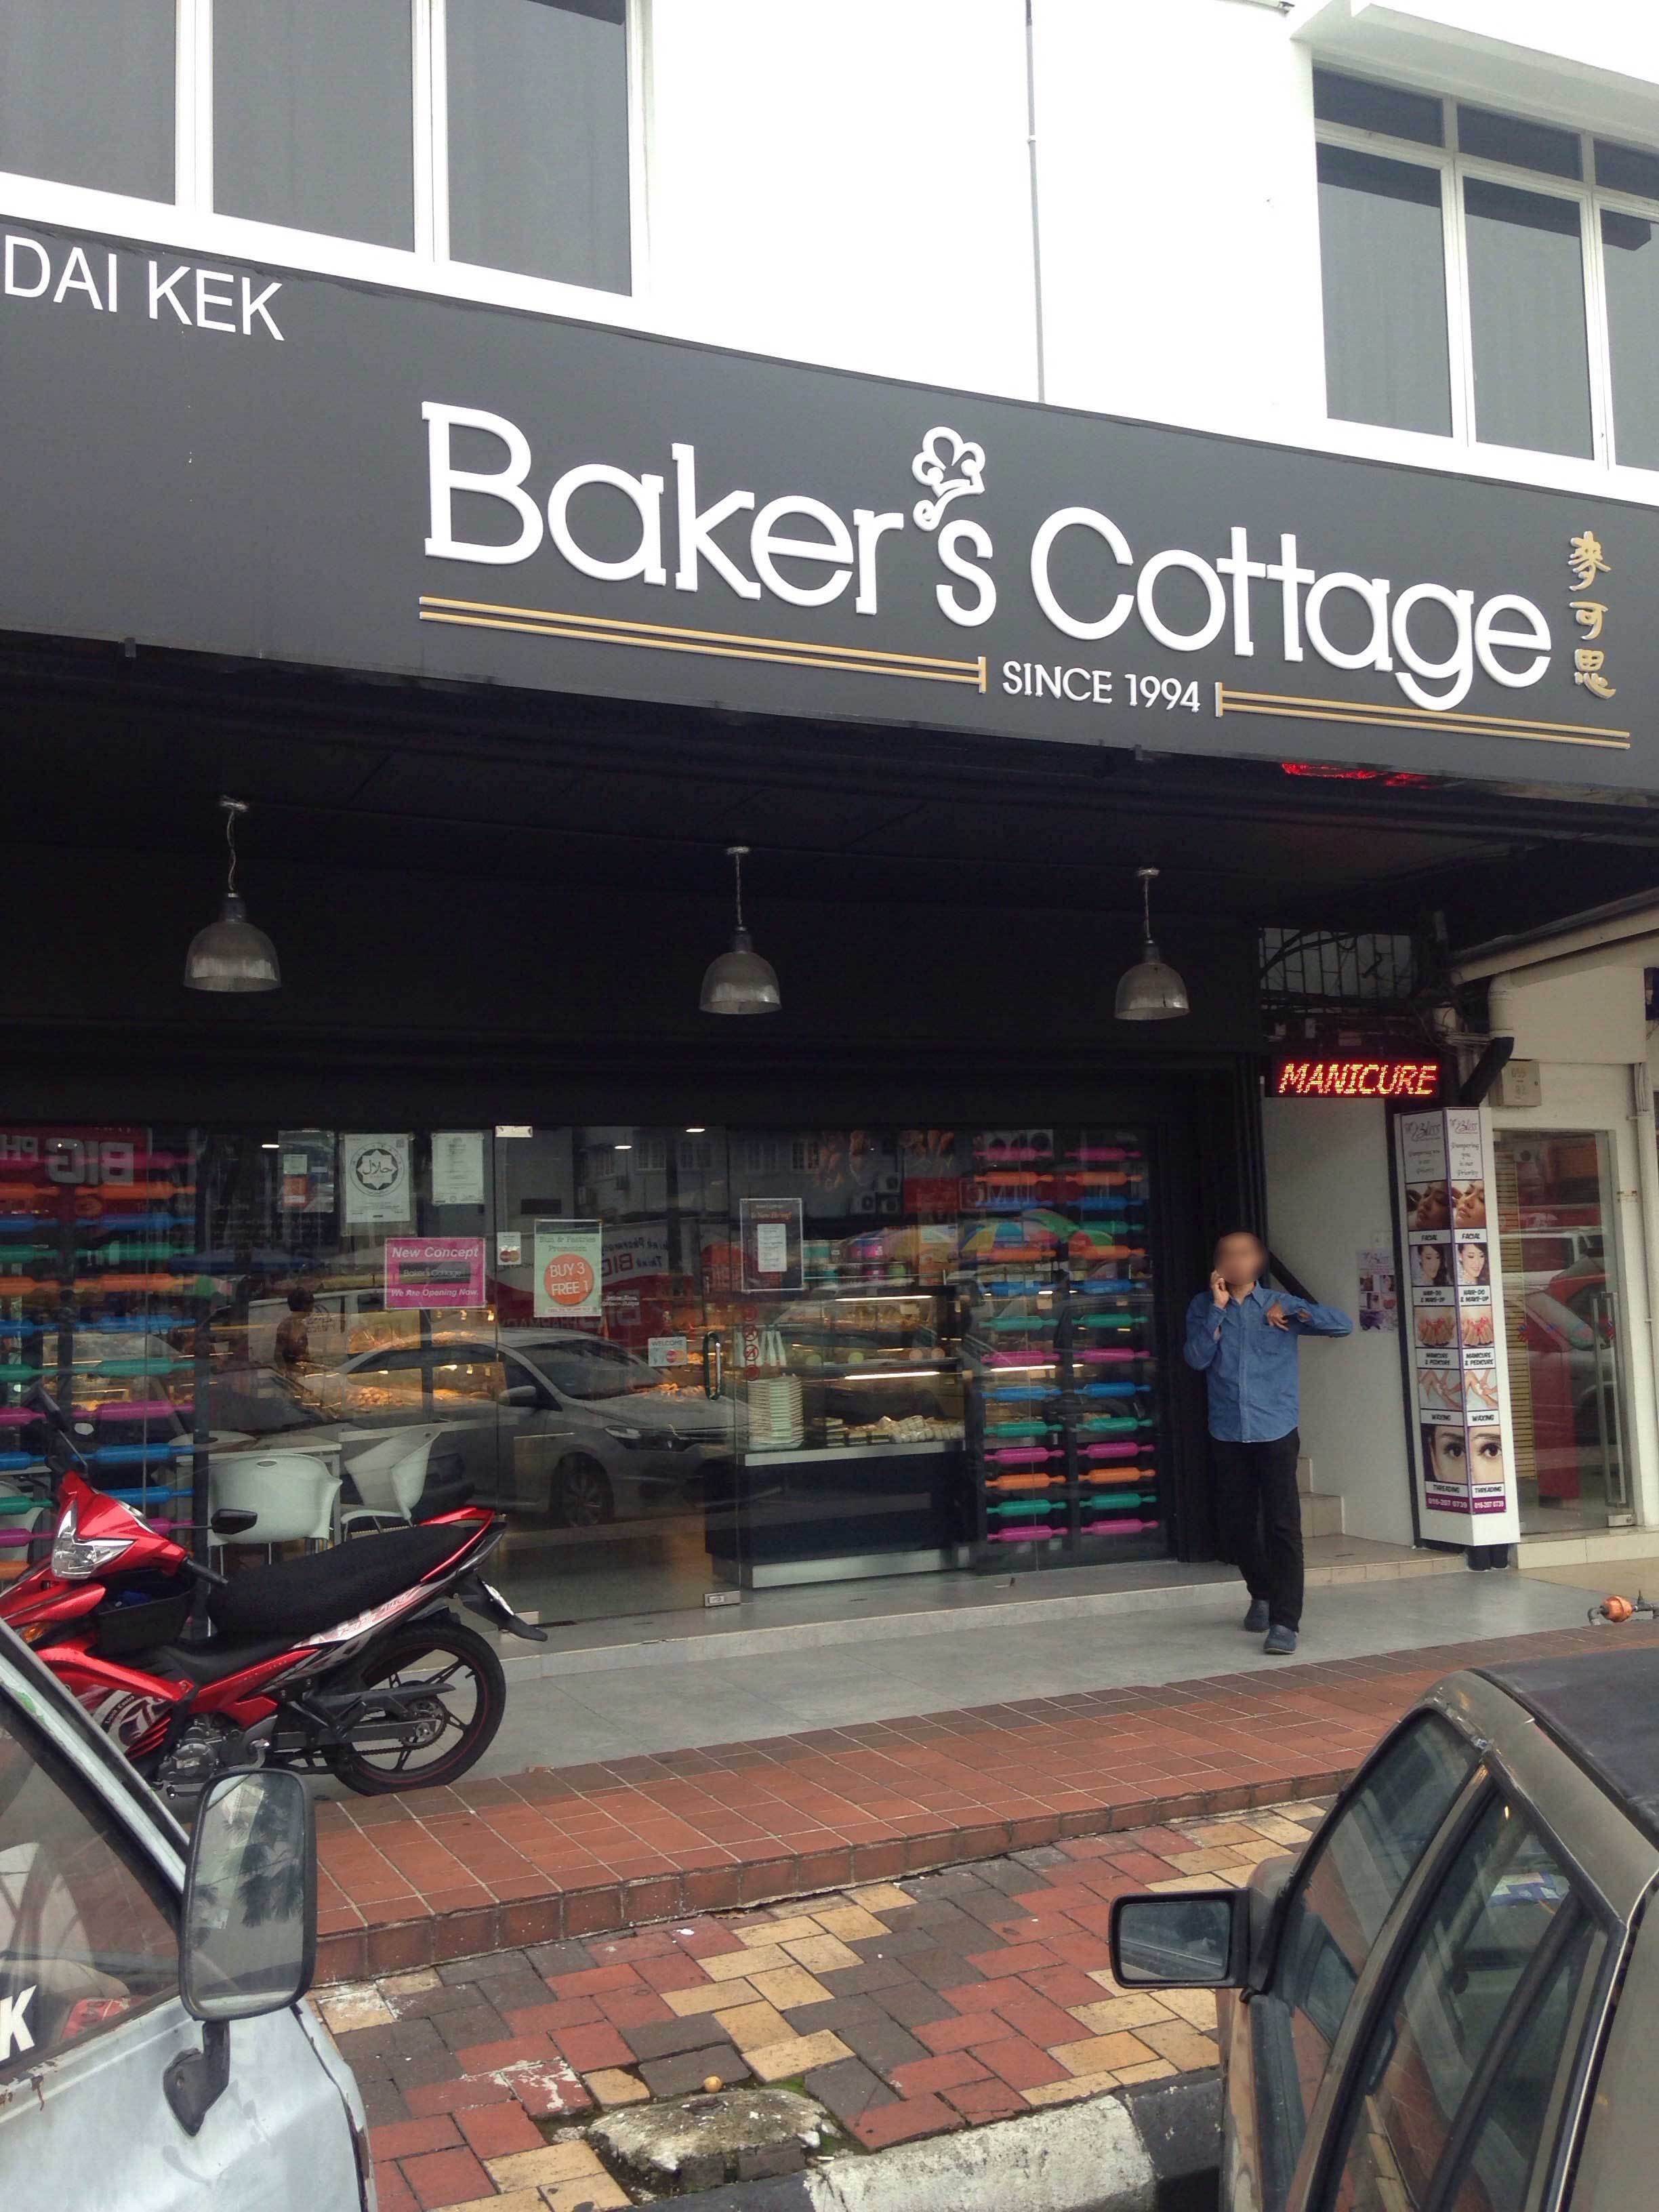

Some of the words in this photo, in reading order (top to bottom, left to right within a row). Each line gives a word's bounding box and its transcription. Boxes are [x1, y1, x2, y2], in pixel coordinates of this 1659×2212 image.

[5, 235, 117, 312] DAI
[148, 260, 285, 341] KEK
[420, 401, 996, 626] Baker's
[1030, 506, 1551, 711] Cottage
[1002, 661, 1113, 704] SINCE
[1124, 674, 1201, 712] 1994
[1278, 1063, 1437, 1094] MANICURE
[363, 1160, 392, 1174] حلال
[392, 1247, 420, 1258] New
[424, 1246, 479, 1259] Concept
[550, 1263, 575, 1277] BUY
[577, 1262, 586, 1275] 3
[422, 1289, 457, 1297] Opening
[552, 1281, 580, 1296] FREE
[585, 1280, 589, 1292] 1
